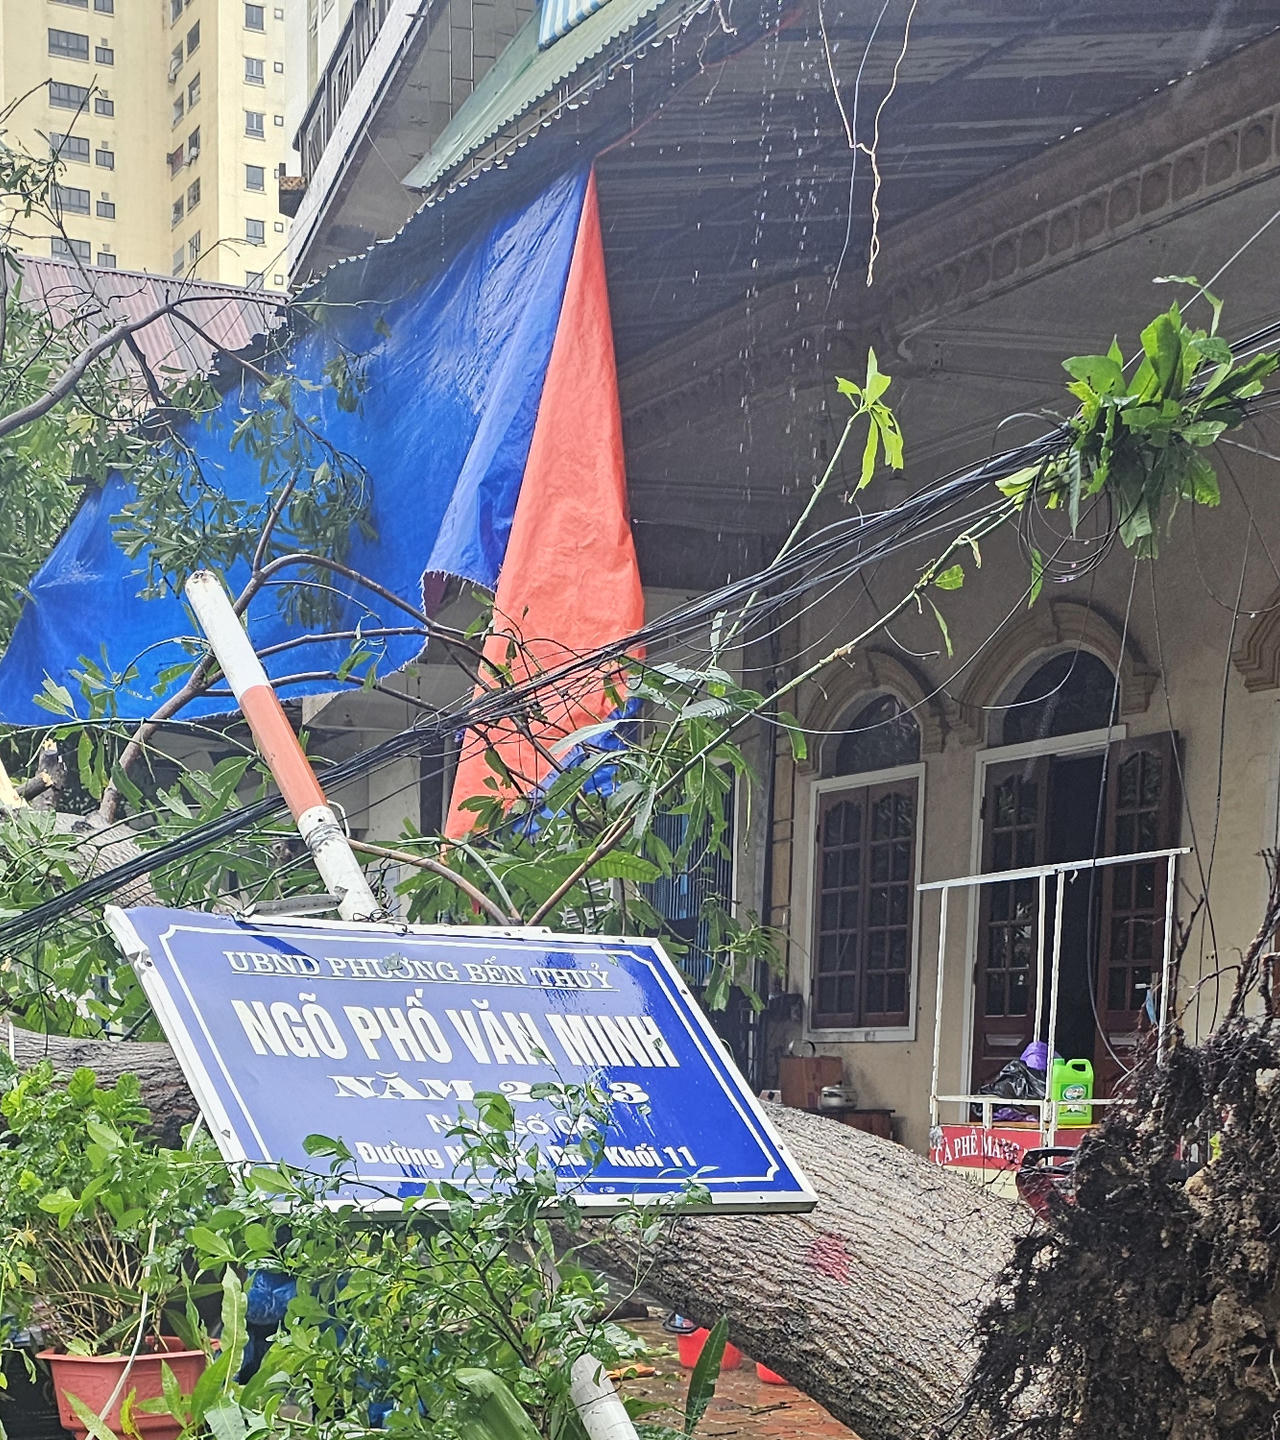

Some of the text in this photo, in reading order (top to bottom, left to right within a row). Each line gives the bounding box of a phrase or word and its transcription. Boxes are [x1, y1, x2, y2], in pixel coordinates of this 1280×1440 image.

[222, 951, 320, 975] UBND
[529, 962, 613, 989] THUỶ
[230, 989, 680, 1068] NGÕ PHỐ VĂN MINH
[326, 1071, 650, 1104] NĂM 23
[515, 1112, 551, 1135] số
[354, 1140, 445, 1169] Đường
[603, 1143, 664, 1167] Khối
[663, 1146, 697, 1167] 11
[954, 1129, 979, 1159] PHÊ
